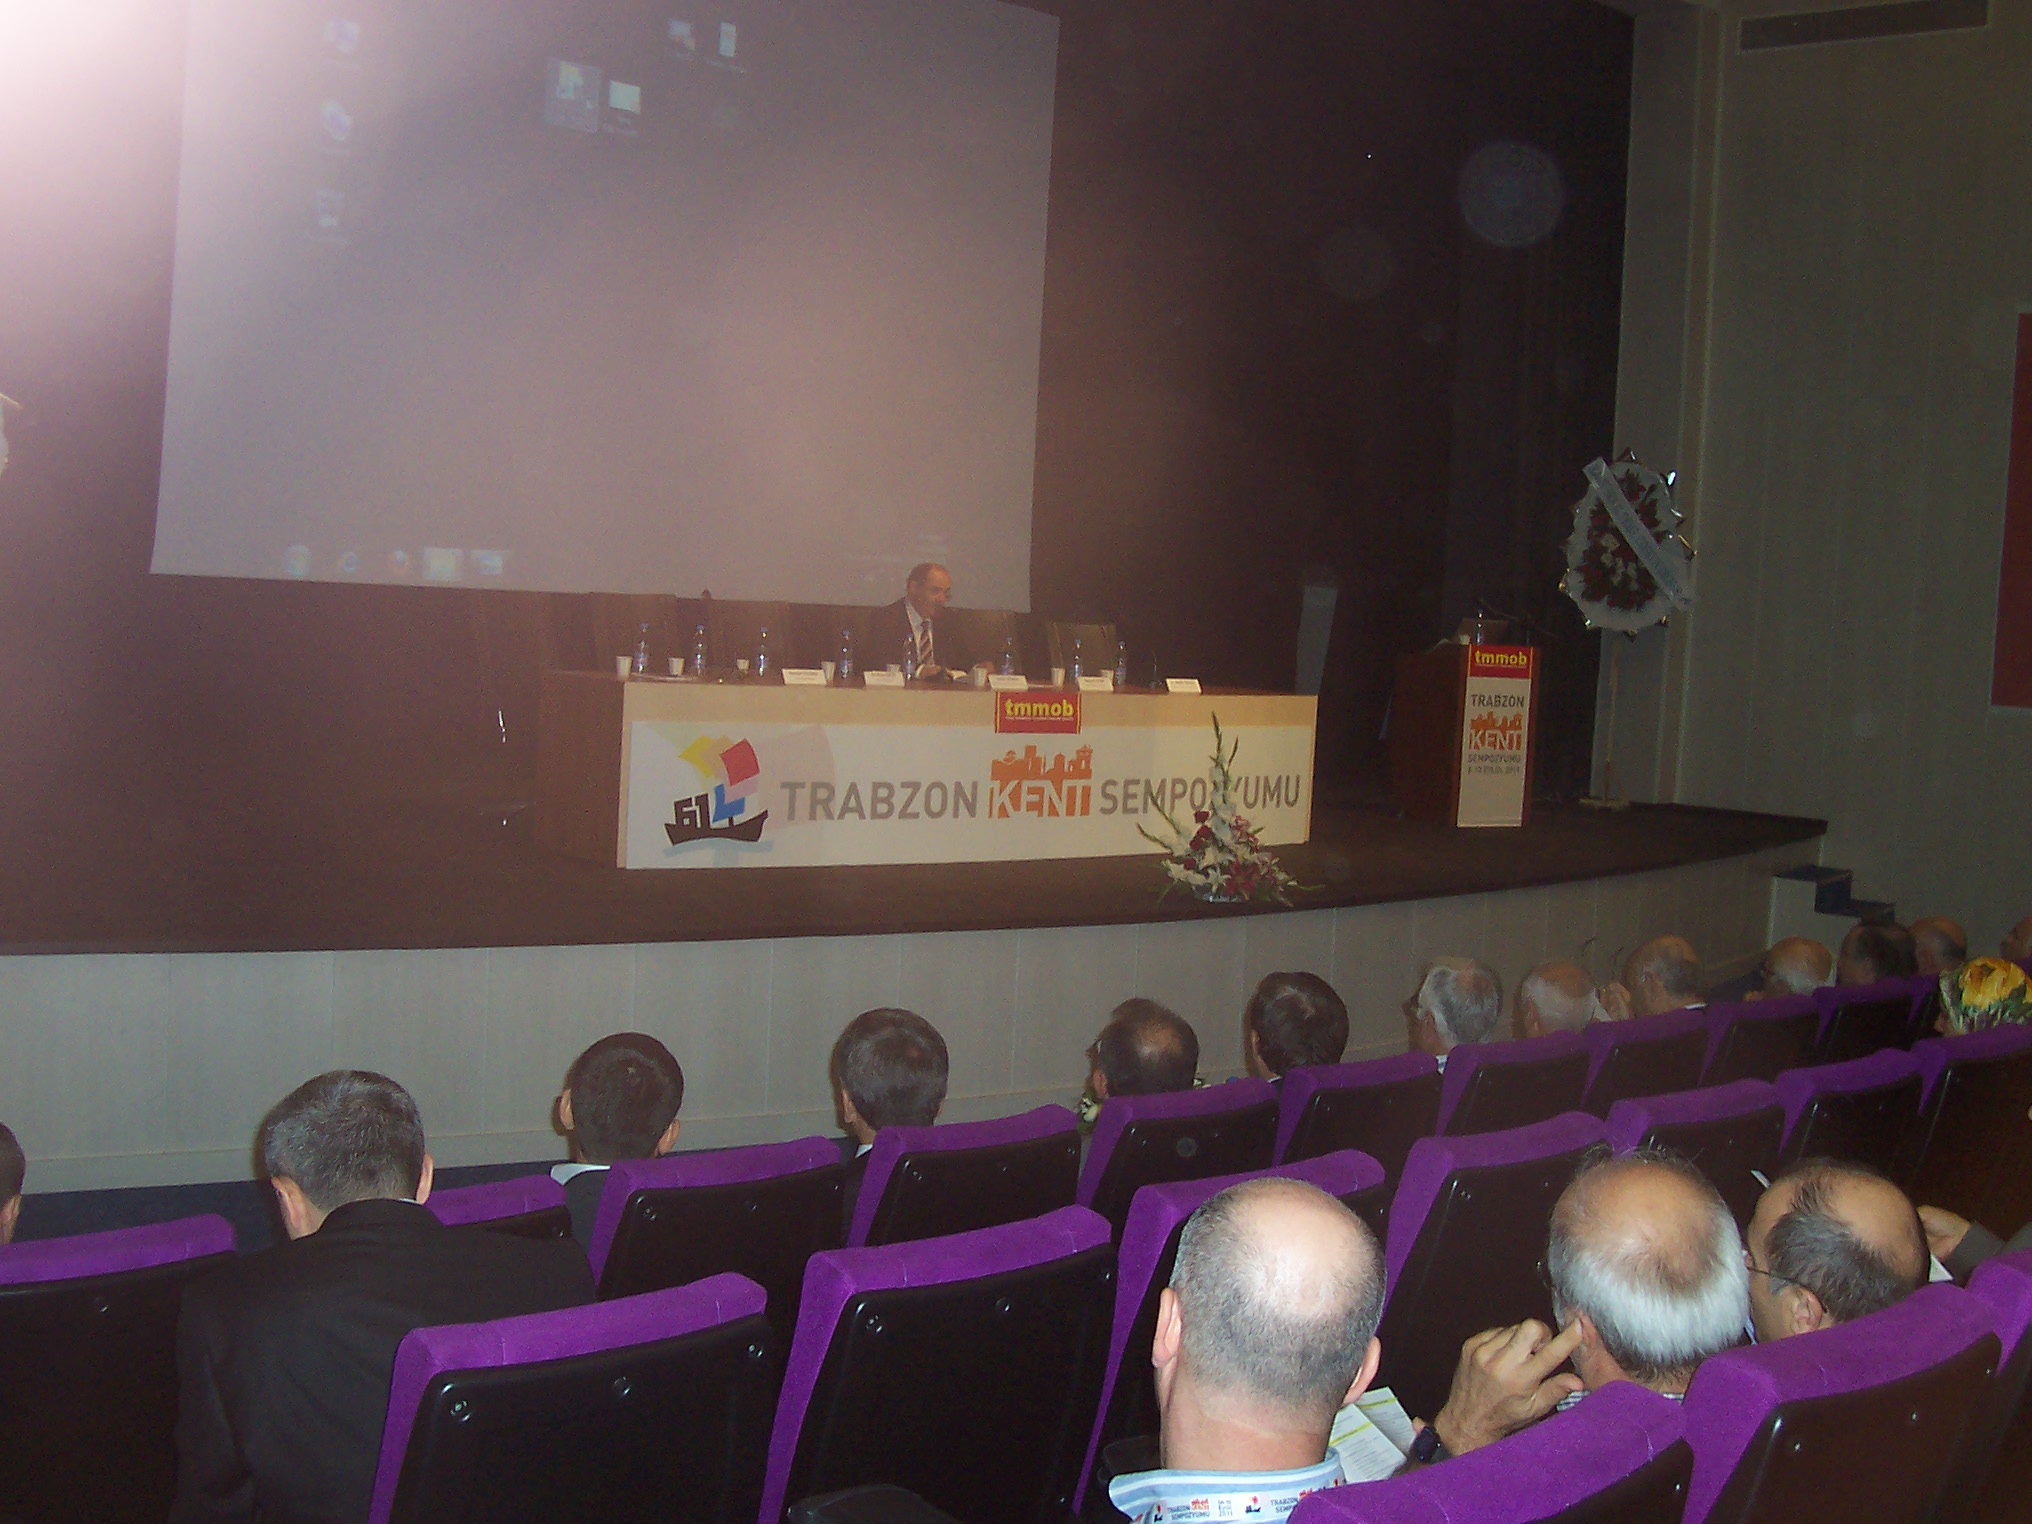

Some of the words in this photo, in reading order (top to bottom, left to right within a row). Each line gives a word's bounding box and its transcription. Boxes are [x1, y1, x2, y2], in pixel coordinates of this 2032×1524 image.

[1474, 650, 1528, 666] tmmob
[1004, 698, 1075, 717] tmmob
[1471, 694, 1525, 709] TRABZON
[1469, 729, 1522, 751] KENT
[780, 780, 978, 821] TRABZON
[988, 779, 1092, 819] KENT
[1099, 774, 1301, 815] SEMPOUMU
